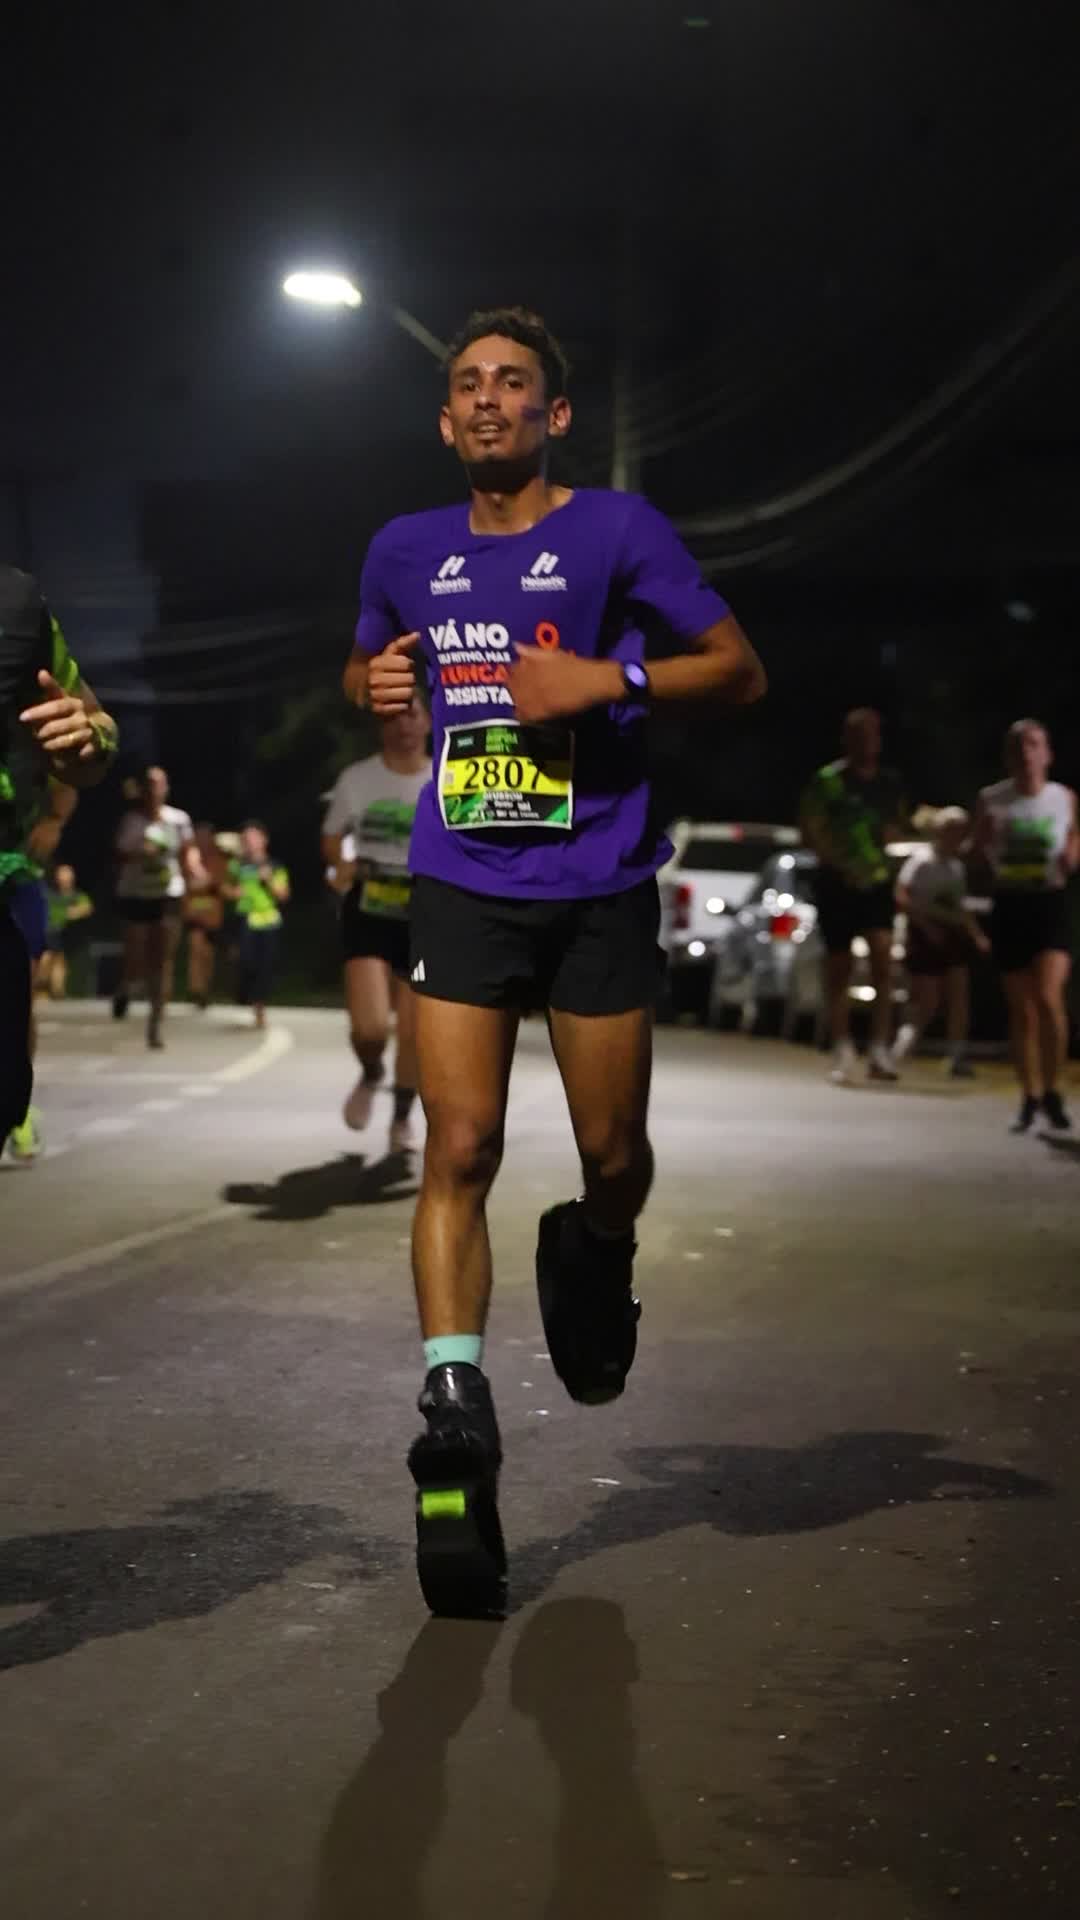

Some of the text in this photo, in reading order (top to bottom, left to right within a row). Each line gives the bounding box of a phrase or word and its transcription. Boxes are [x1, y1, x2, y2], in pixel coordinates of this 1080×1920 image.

[428, 618, 509, 650] VÁ NO
[444, 685, 515, 706] DESISTA
[464, 757, 541, 791] 2807
